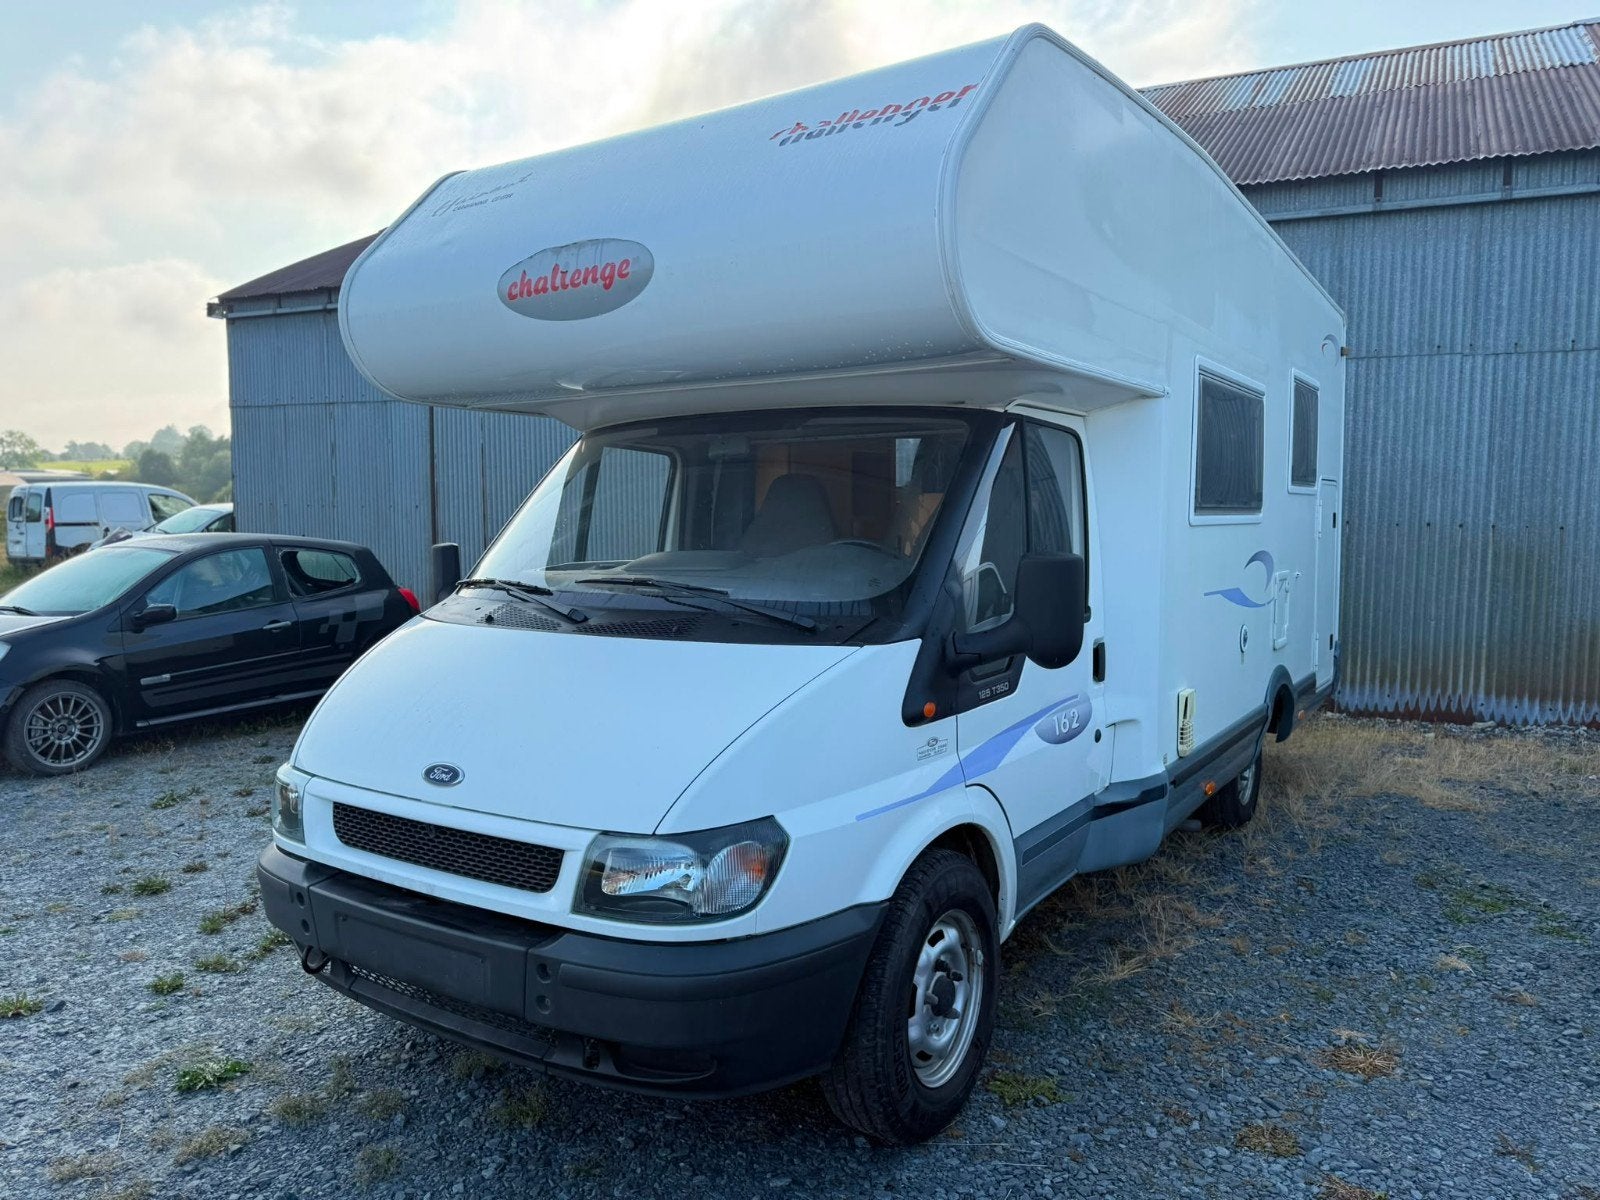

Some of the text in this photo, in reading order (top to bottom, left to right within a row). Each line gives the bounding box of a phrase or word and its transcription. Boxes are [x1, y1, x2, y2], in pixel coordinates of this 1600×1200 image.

[991, 681, 1010, 695] T350
[1053, 709, 1080, 736] 162
[429, 766, 453, 781] Ford
